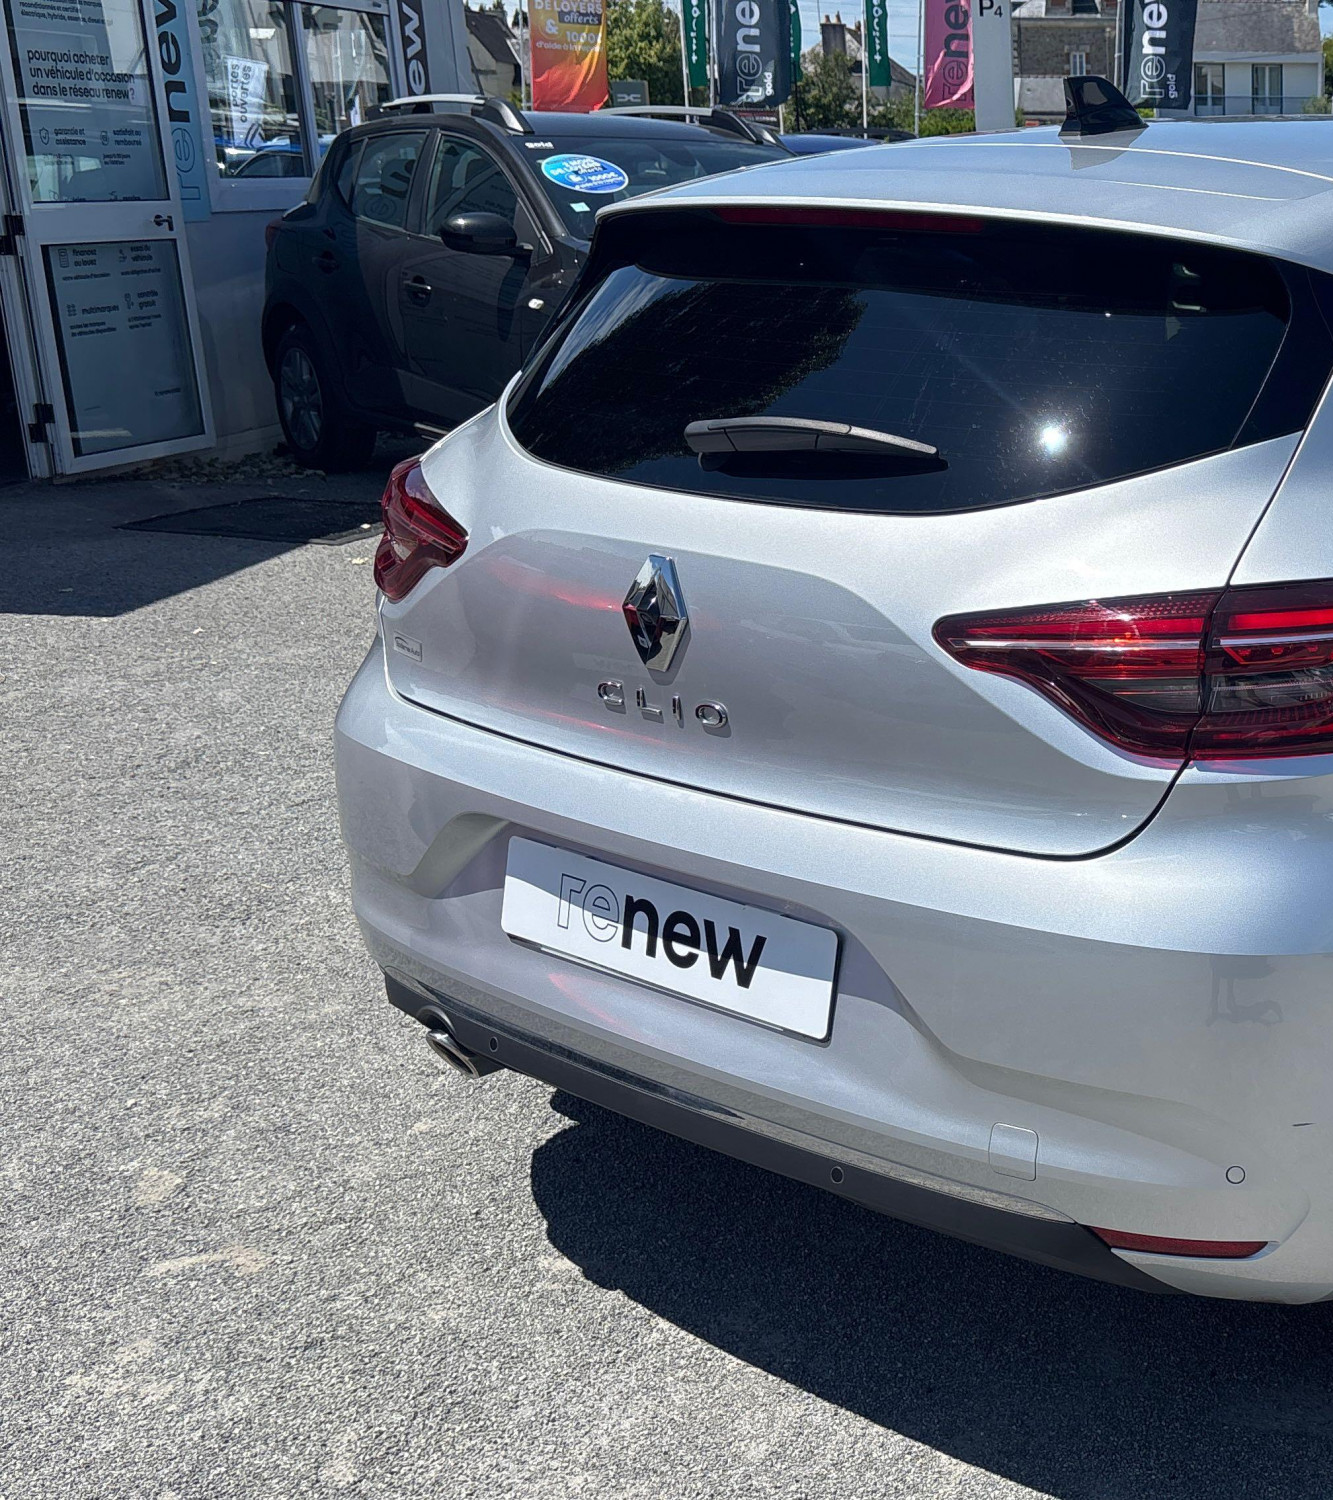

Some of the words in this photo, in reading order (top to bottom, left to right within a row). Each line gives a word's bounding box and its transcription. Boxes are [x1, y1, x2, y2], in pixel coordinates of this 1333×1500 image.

[535, 0, 551, 10] DE
[554, 0, 603, 14] LOYERS
[564, 12, 598, 24] offerts
[27, 49, 71, 64] pourquoi
[73, 51, 109, 66] acheter
[402, 2, 425, 95] ew
[943, 1, 970, 102] rene
[1141, 0, 1168, 98] rene
[30, 67, 43, 78] un
[44, 66, 84, 81] véhicule
[86, 69, 135, 83] d'occasion
[765, 71, 774, 96] gold
[1167, 73, 1178, 99] gold
[32, 82, 58, 97] dans
[58, 84, 67, 97] le
[68, 83, 100, 99] réseau
[597, 679, 729, 730] CLIO
[557, 873, 767, 989] renew
